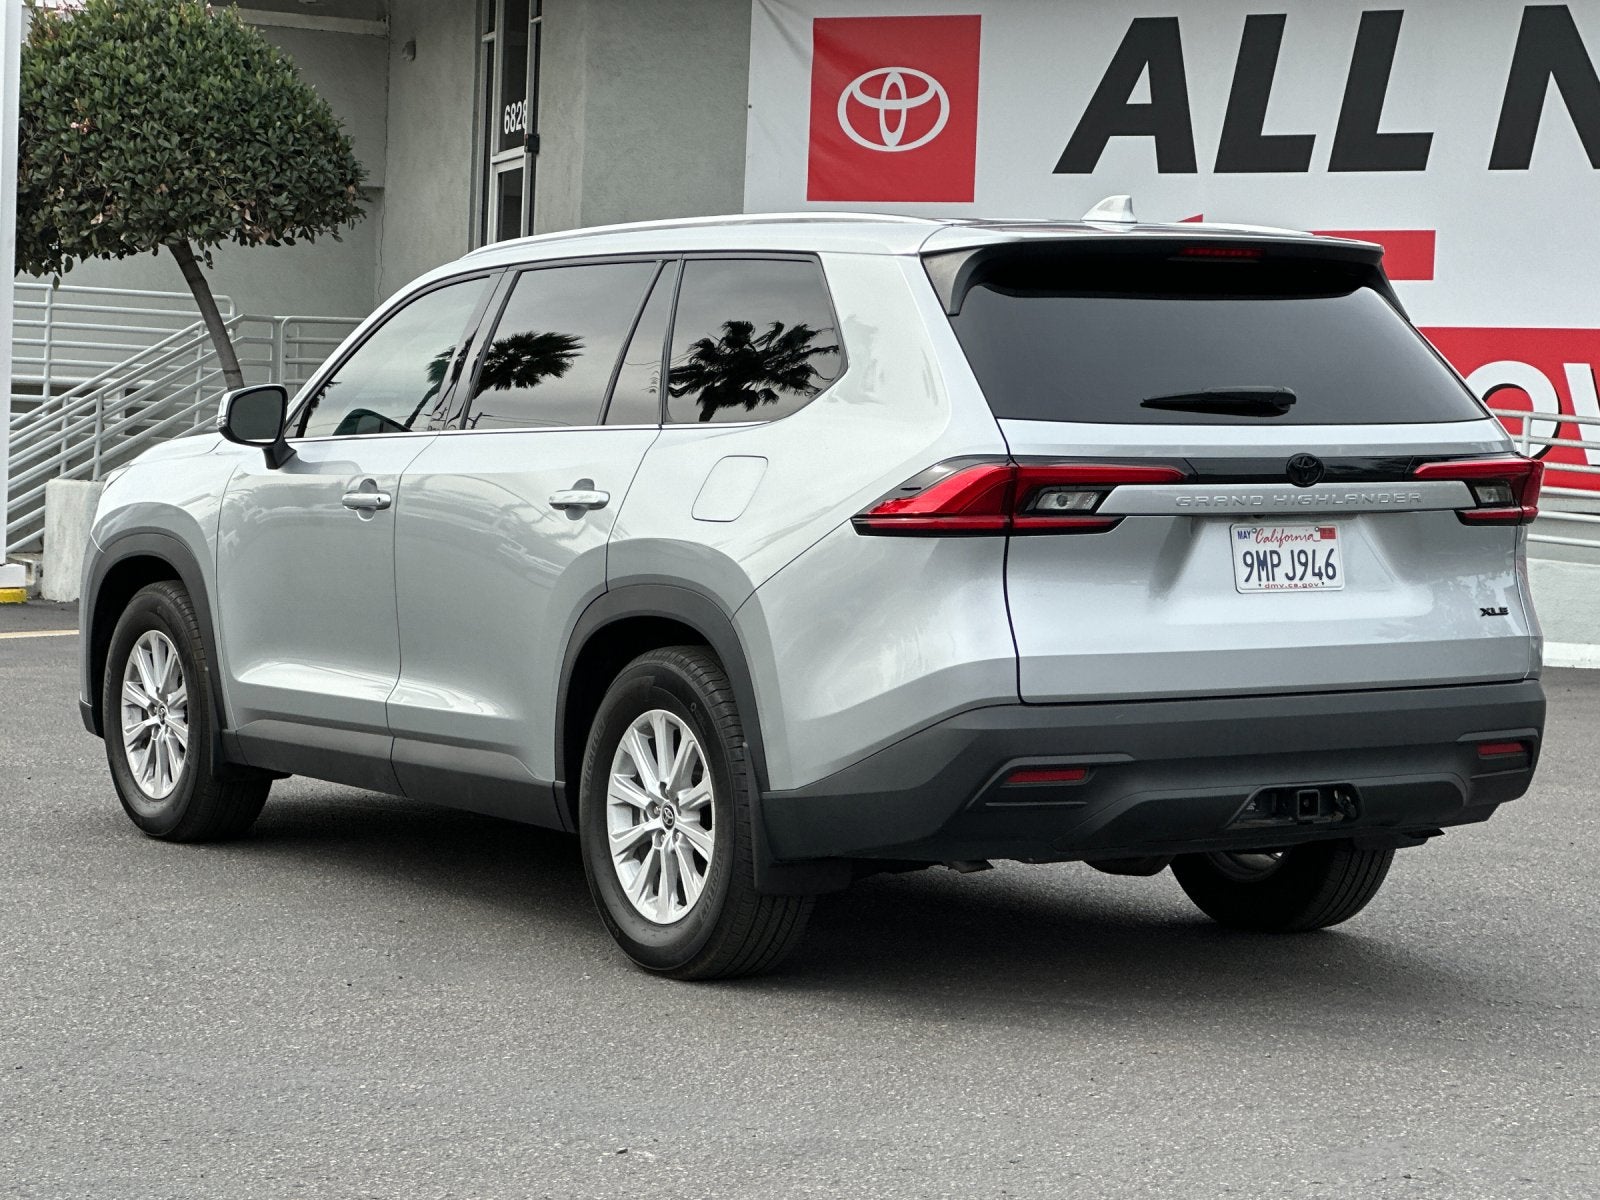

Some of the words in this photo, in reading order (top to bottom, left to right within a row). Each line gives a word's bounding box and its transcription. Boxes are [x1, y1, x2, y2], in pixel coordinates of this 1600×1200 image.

[1051, 9, 1434, 174] ALL
[1465, 360, 1600, 466] O
[1175, 495, 1264, 507] GRAND
[1272, 492, 1423, 506] HIGHLANDER
[1237, 530, 1251, 540] MAY
[1255, 528, 1321, 548] California
[1242, 548, 1337, 583] 9MPJ946
[1479, 606, 1509, 617] XLE
